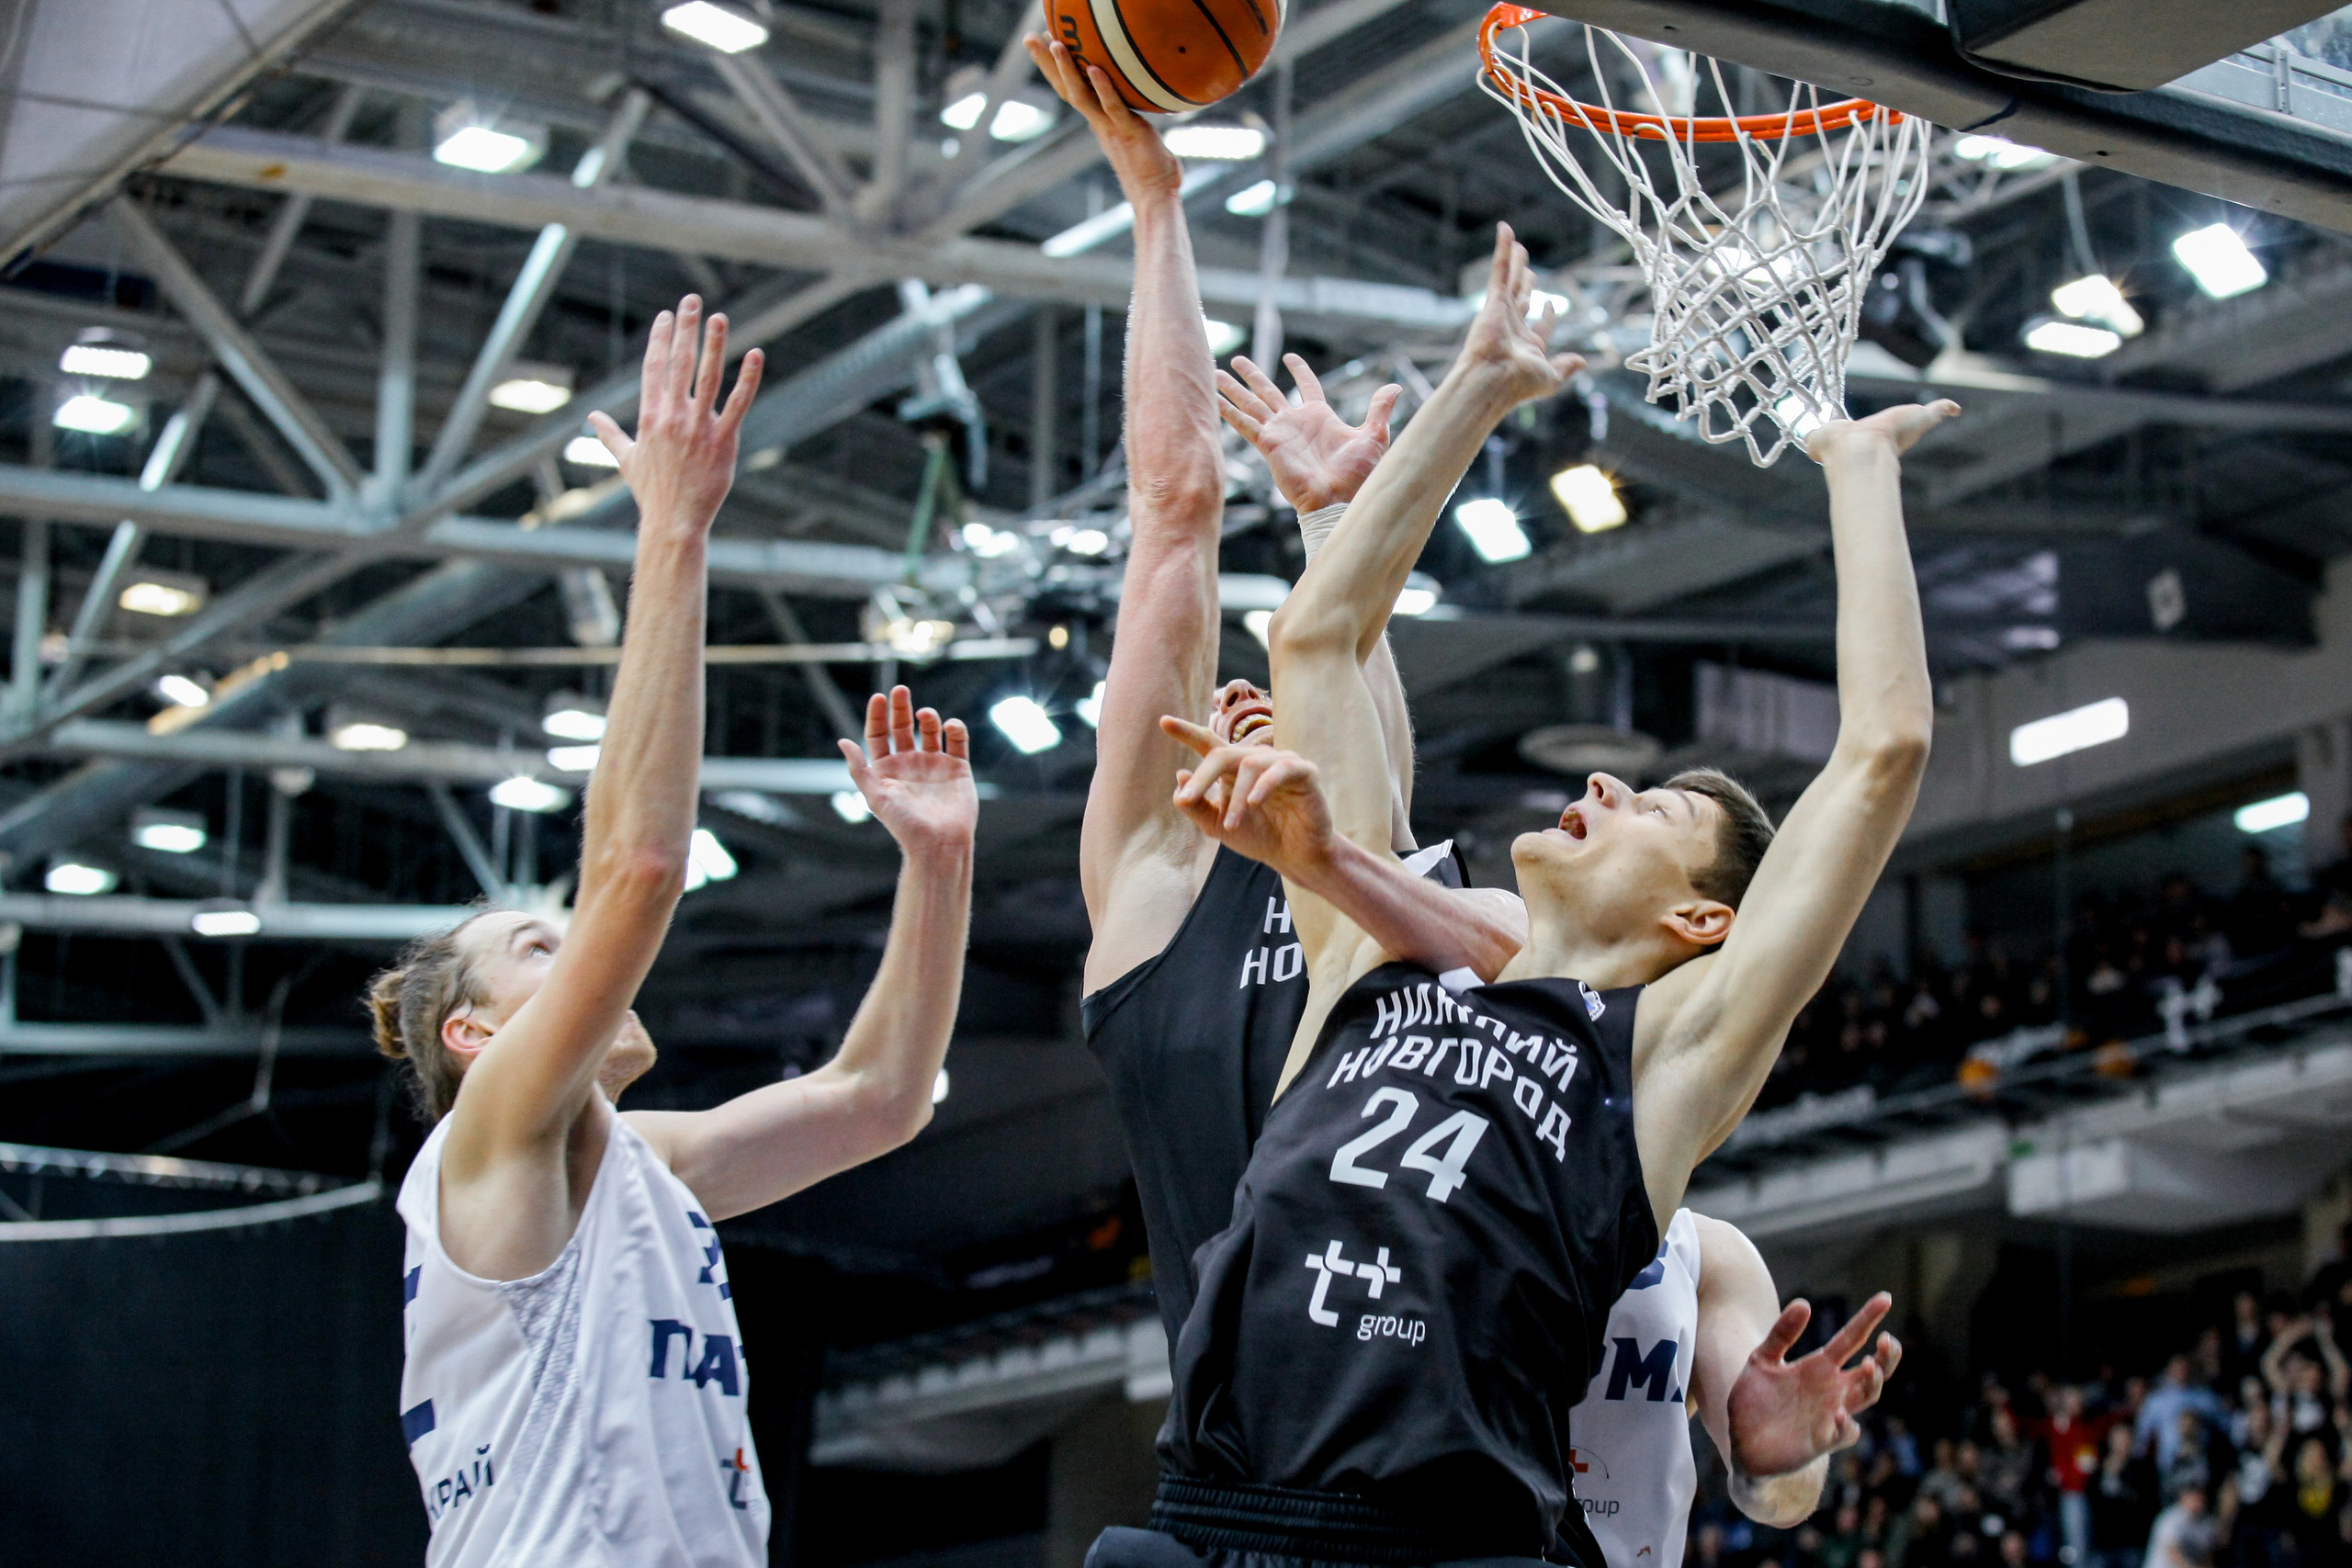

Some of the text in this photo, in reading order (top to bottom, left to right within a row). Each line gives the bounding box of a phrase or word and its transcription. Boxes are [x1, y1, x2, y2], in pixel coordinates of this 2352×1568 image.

[1263, 896, 1291, 933] Н
[1239, 942, 1308, 989] НО
[1327, 1035, 1572, 1163] НОВГОРОД
[1329, 1087, 1489, 1202] 24
[648, 1319, 744, 1396] ПА
[1357, 1314, 1426, 1347] group
